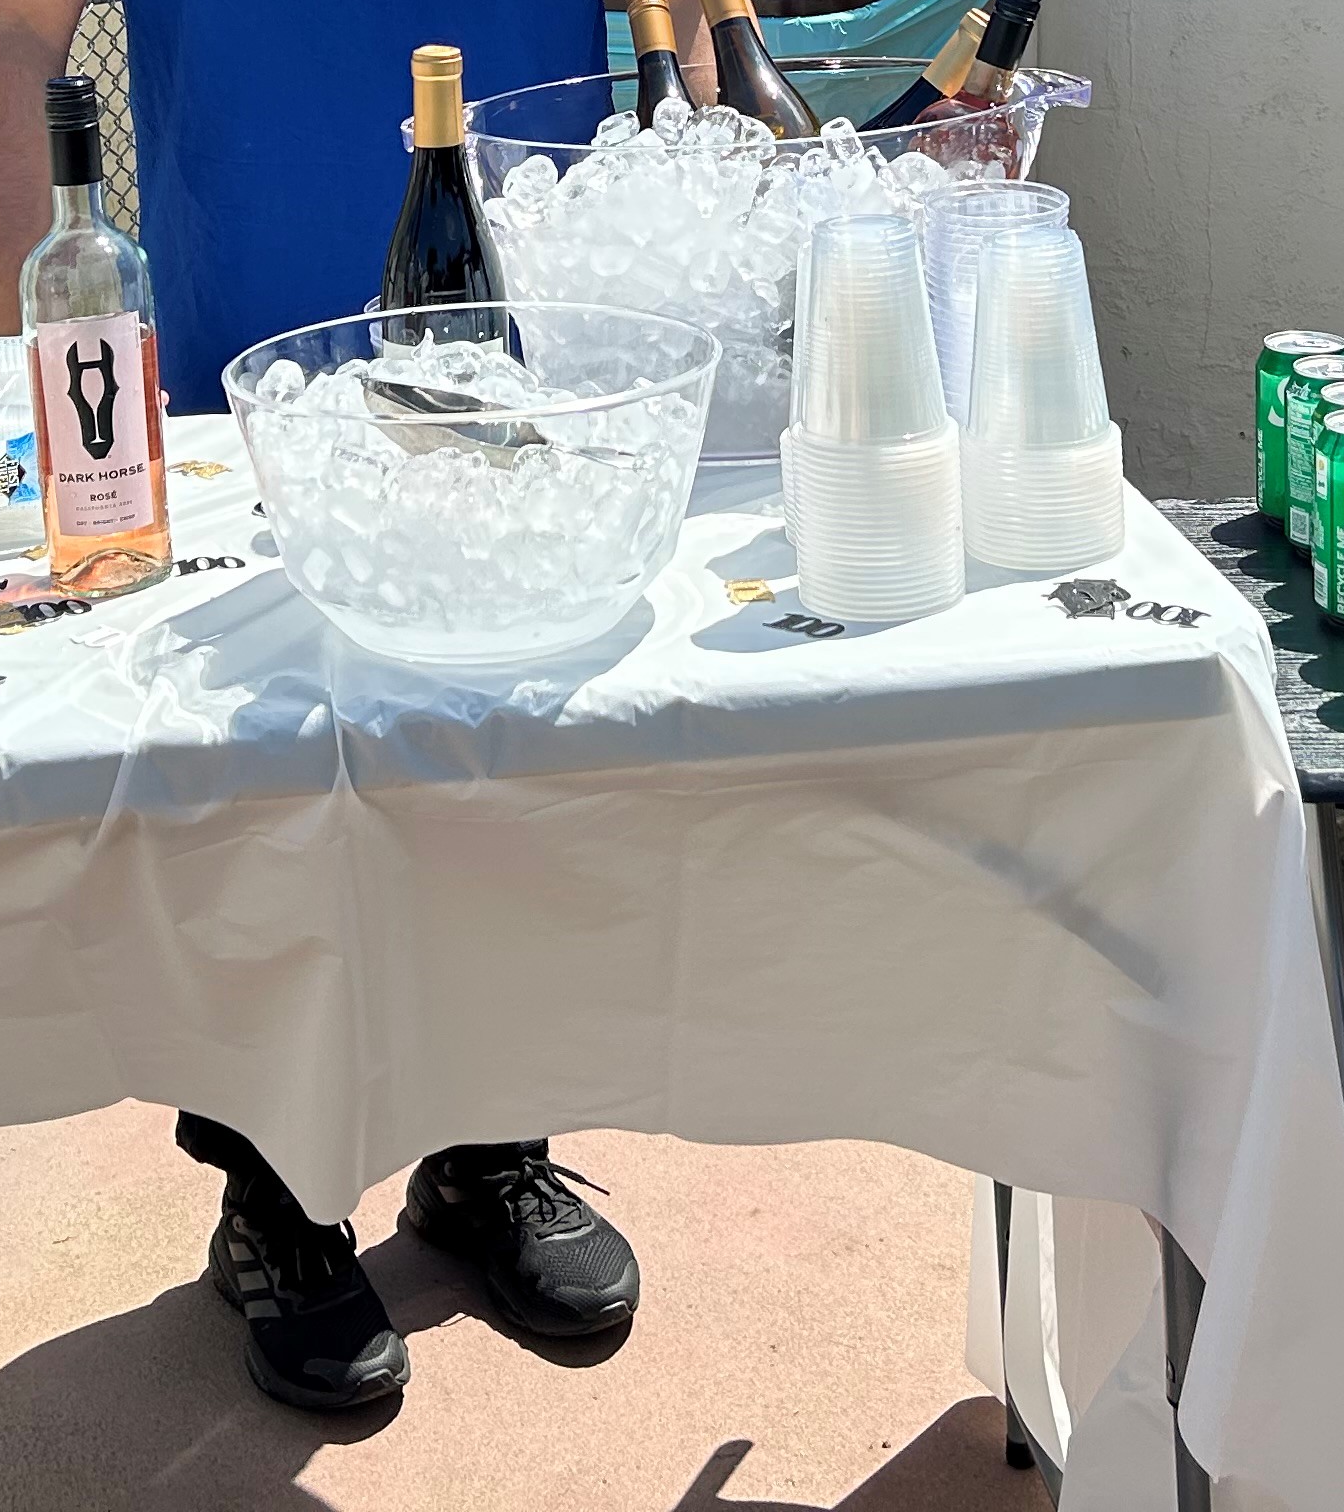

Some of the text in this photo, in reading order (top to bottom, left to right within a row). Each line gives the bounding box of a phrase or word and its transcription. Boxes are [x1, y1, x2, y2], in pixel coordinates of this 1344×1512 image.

[1257, 428, 1263, 450] ME
[58, 462, 145, 483] DARK HORSE
[89, 489, 118, 502] ROSÉ
[173, 555, 247, 577] 100
[761, 611, 847, 638] 100
